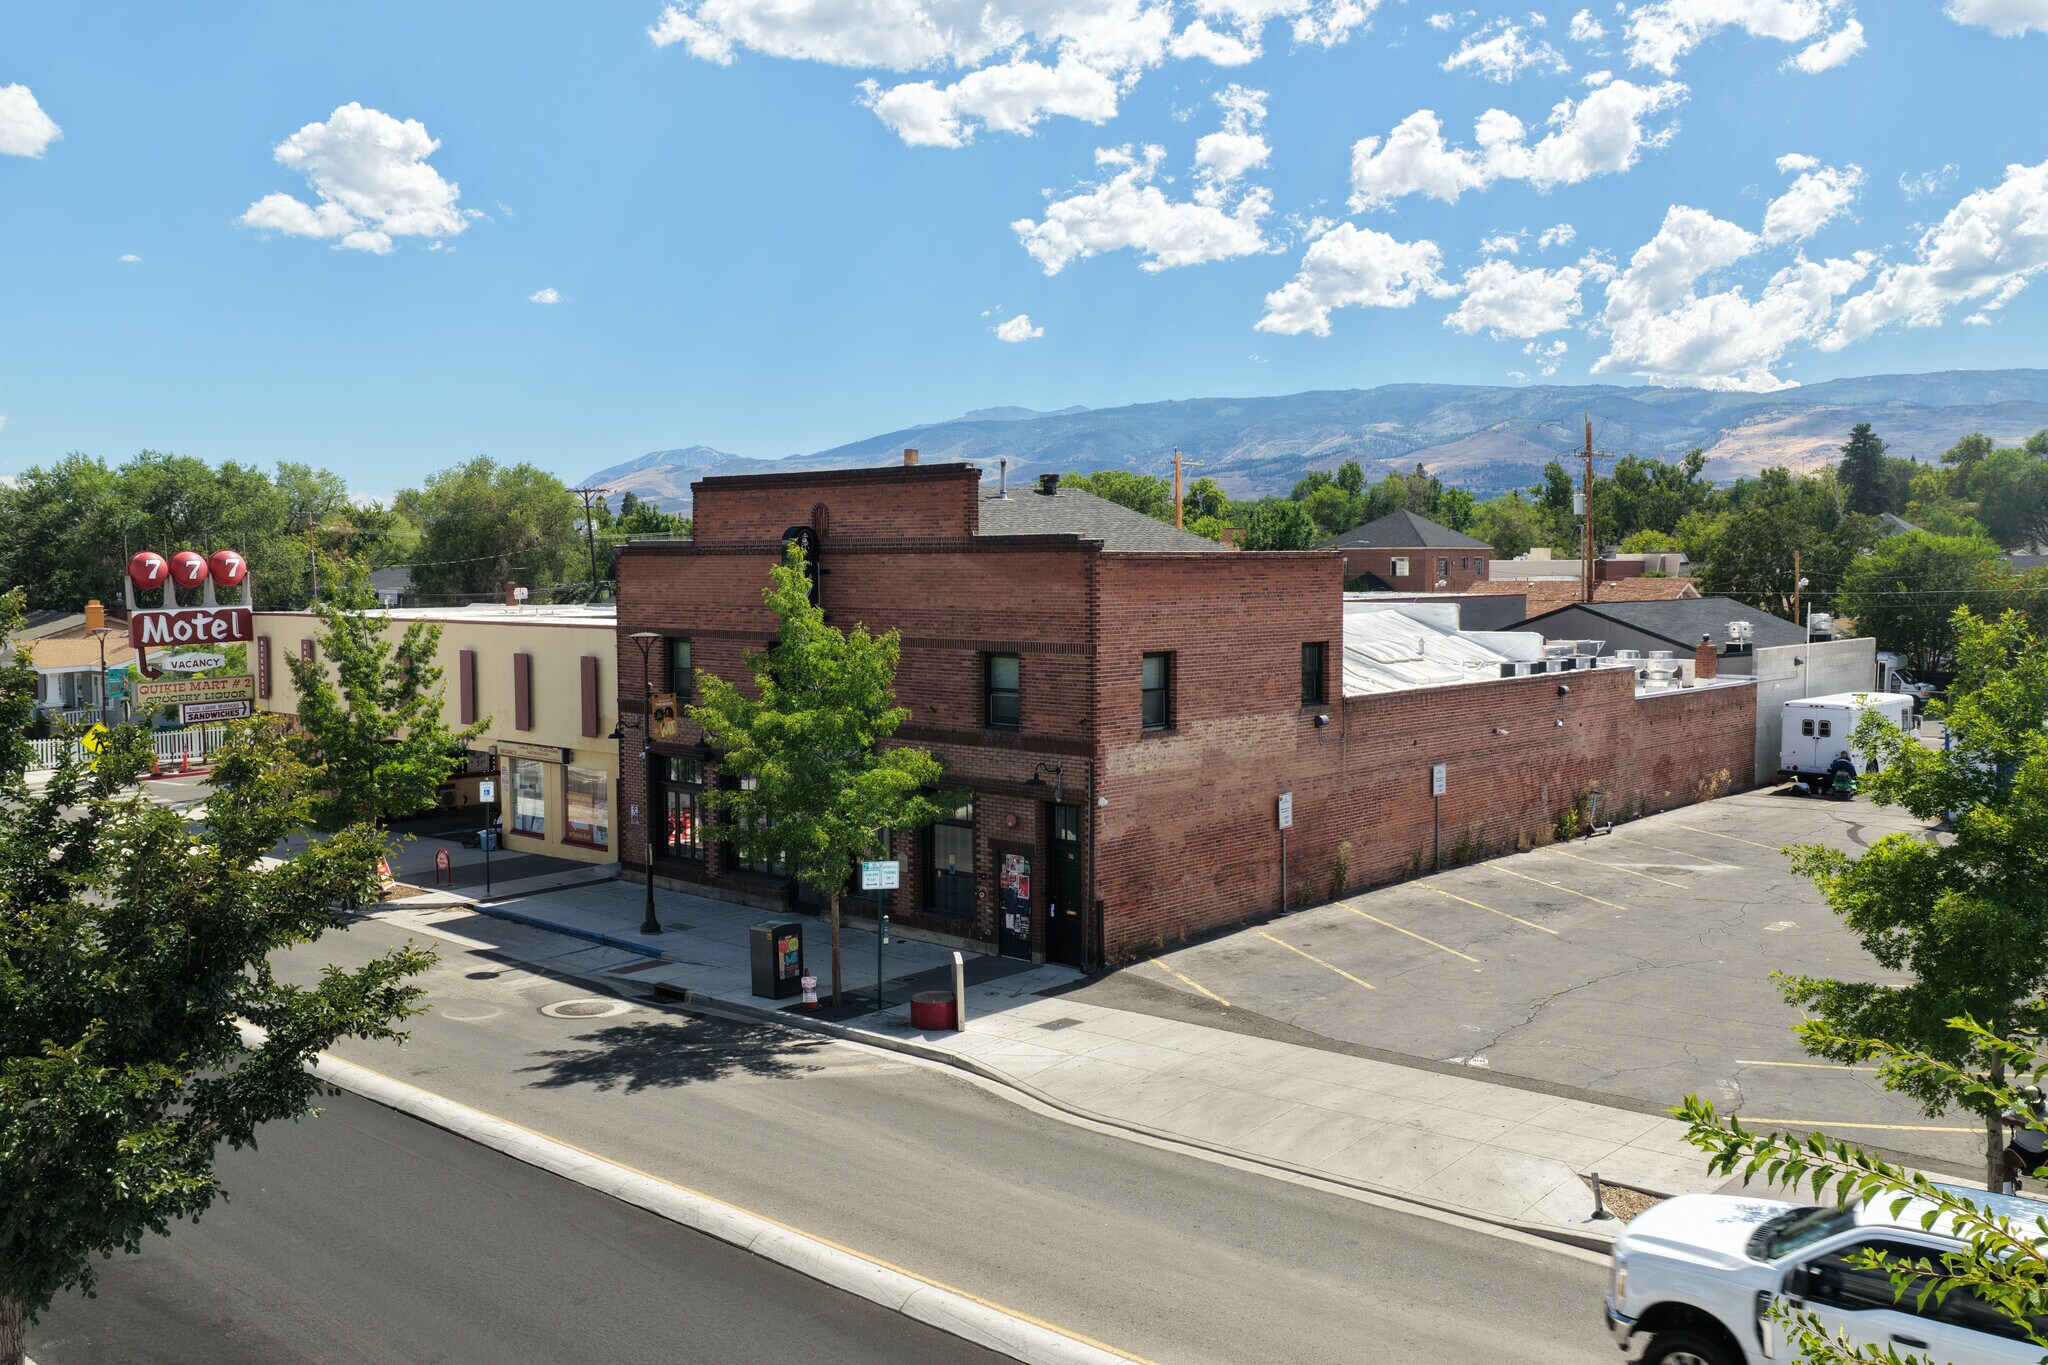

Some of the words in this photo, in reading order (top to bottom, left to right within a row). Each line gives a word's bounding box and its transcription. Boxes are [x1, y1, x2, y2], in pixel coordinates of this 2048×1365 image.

[145, 559, 161, 579] 7
[185, 560, 201, 580] 7
[225, 558, 240, 578] 7
[141, 611, 243, 644] Motel
[170, 658, 220, 669] VACANCY
[139, 682, 186, 695] QUIKIE
[189, 680, 228, 691] MART
[232, 679, 241, 689] #
[244, 678, 251, 688] 2
[146, 693, 201, 704] GROCERY
[204, 690, 246, 700] LIQUOR
[187, 710, 240, 721] SANDWICHES
